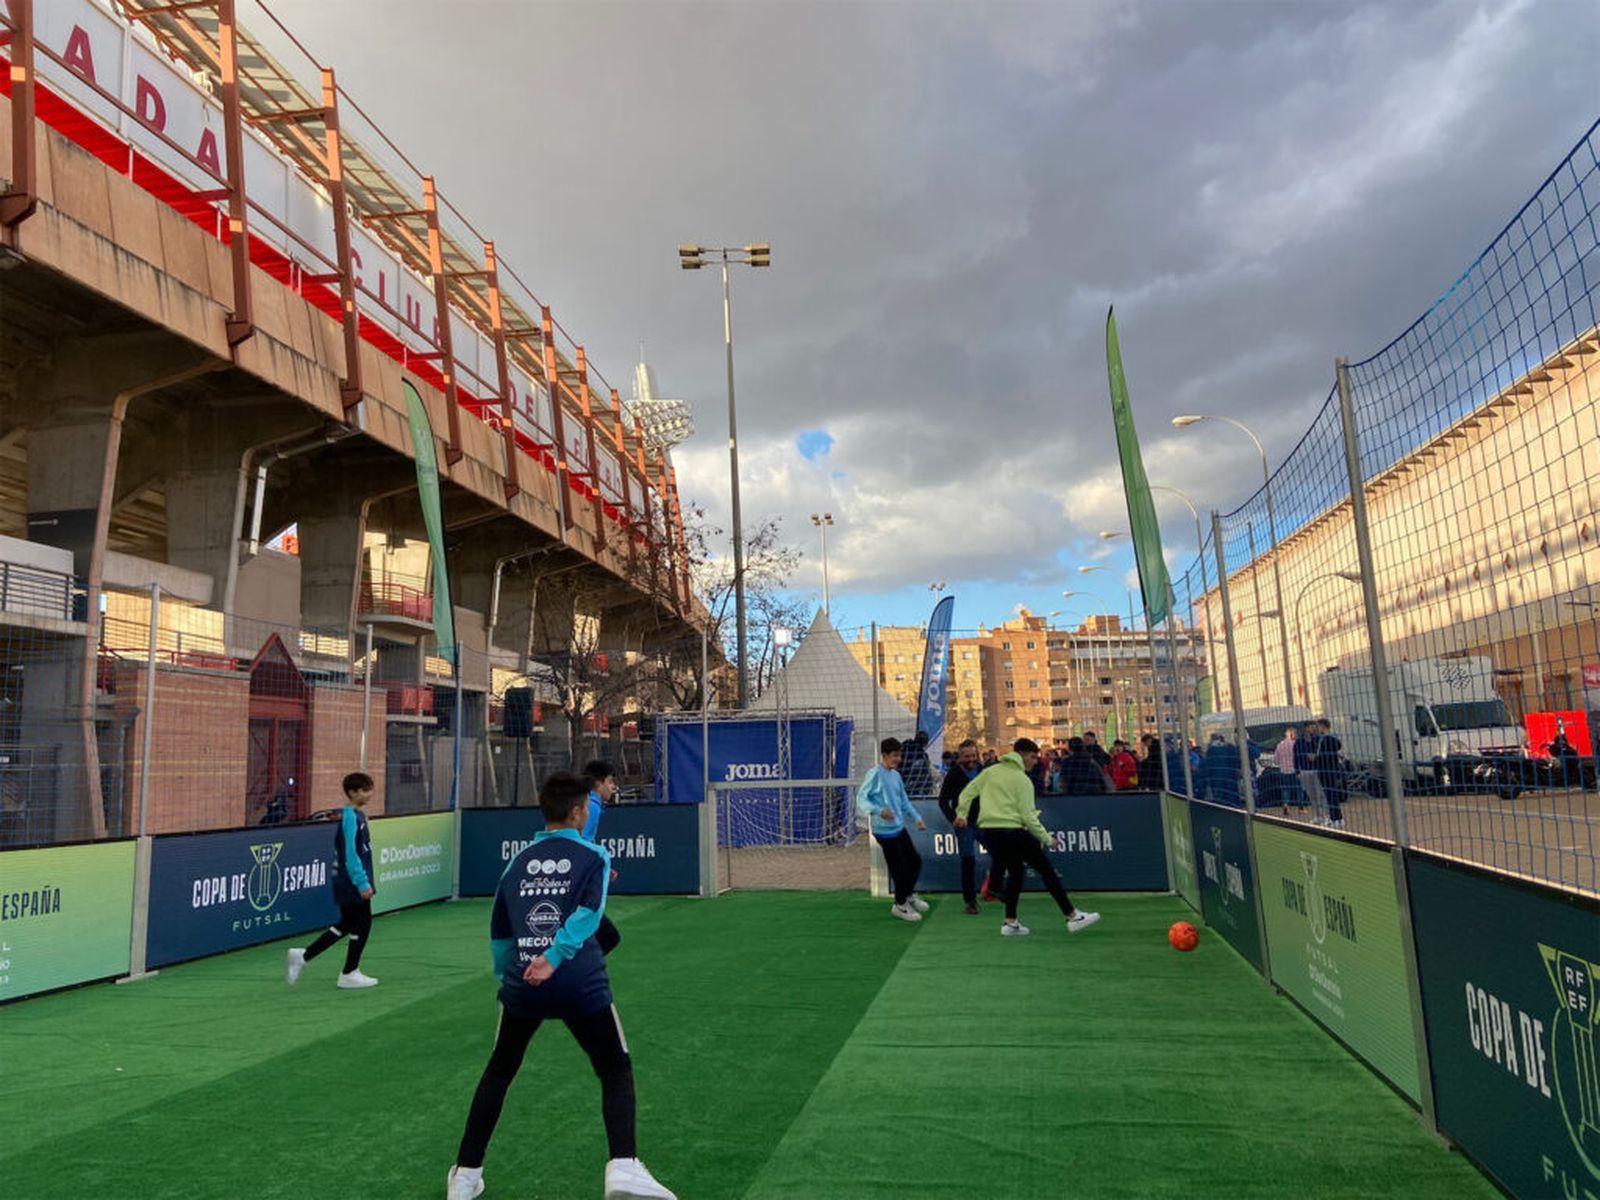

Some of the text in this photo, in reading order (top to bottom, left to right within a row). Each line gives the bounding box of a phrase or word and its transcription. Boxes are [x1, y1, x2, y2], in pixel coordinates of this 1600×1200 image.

[2, 885, 61, 920] ESPAÑA
[192, 859, 326, 908] COPA DE ESPAÑA
[232, 912, 291, 931] FUTSAL
[1465, 981, 1551, 1098] COPA DE
